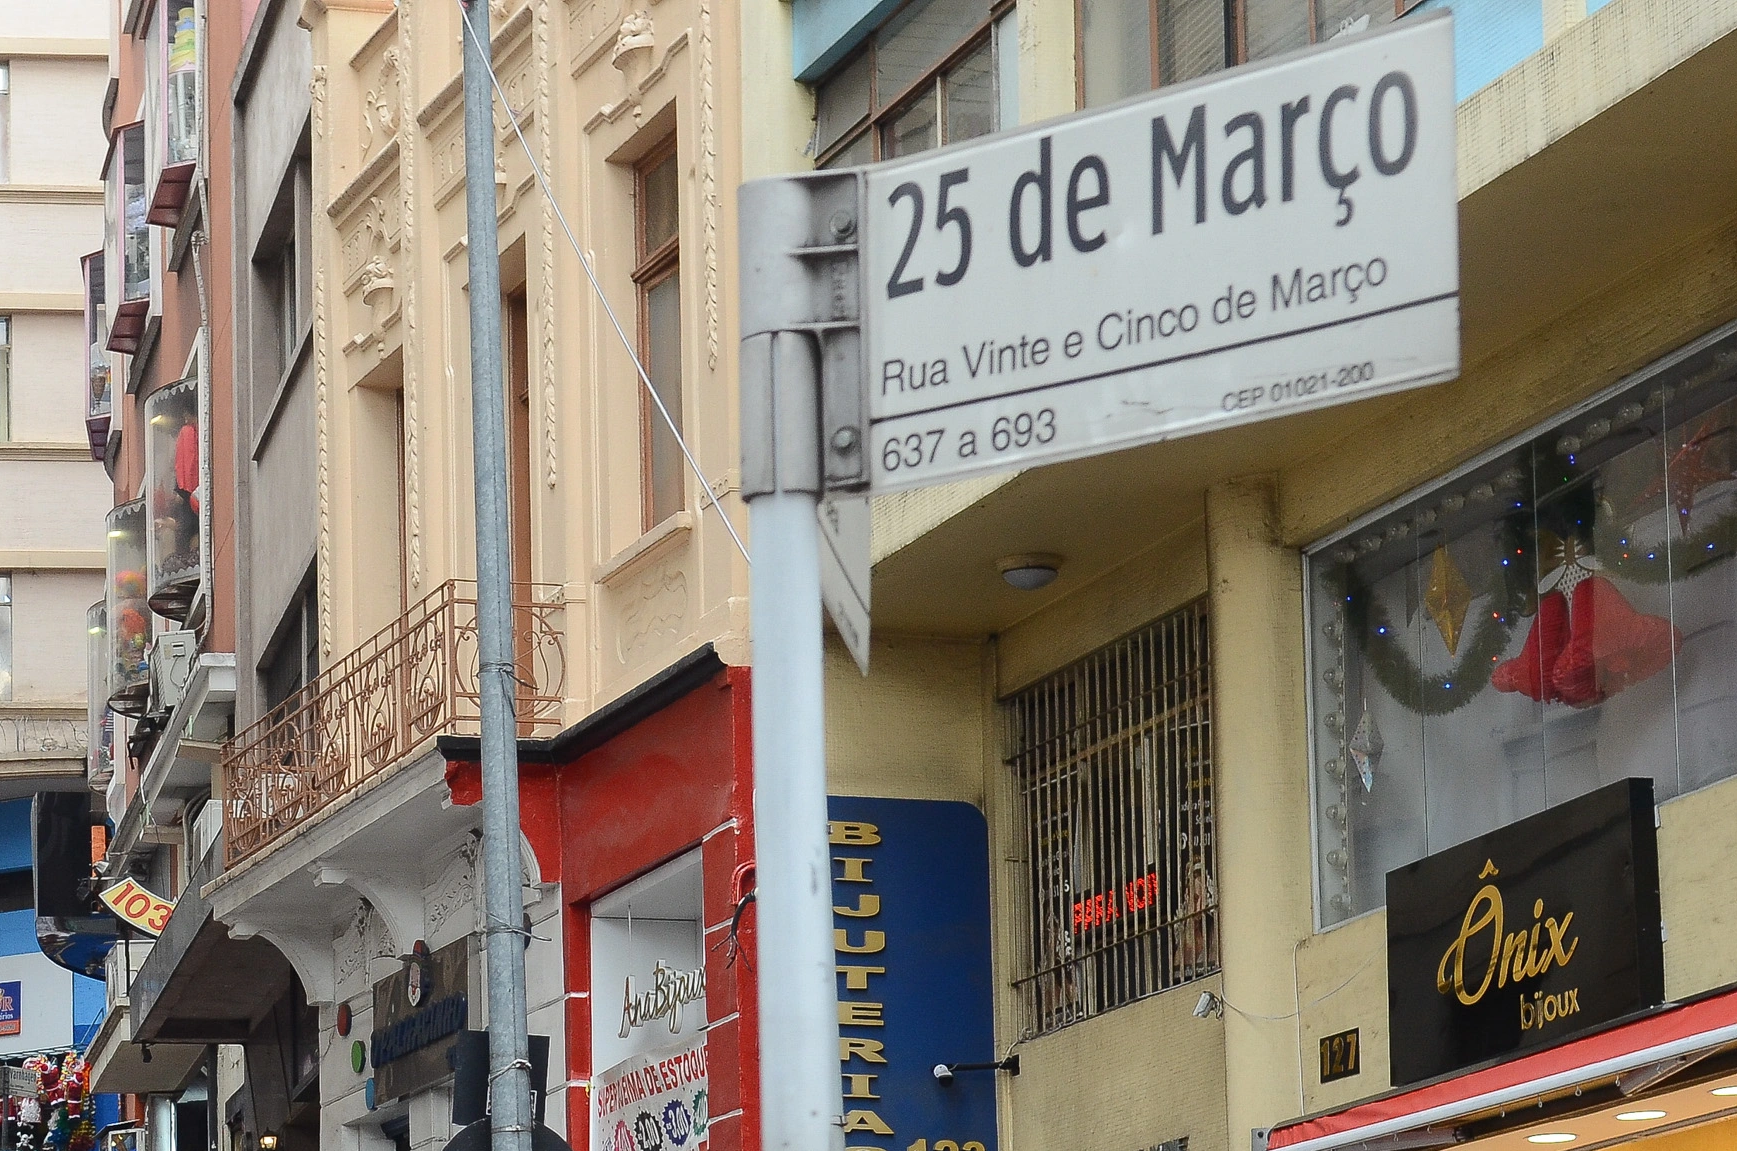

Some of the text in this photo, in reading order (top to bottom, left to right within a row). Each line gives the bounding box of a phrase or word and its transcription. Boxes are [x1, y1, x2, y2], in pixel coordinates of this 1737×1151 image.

[885, 70, 1419, 300] 25 de Março
[881, 253, 1388, 396] Rua Vinte e Cinco de Março
[1222, 361, 1375, 412] CEP 01021-200
[881, 409, 1056, 473] 637 a 693
[112, 882, 174, 932] 103
[1437, 858, 1579, 1006] Ônix
[1520, 987, 1581, 1030] bijoux
[1321, 1034, 1357, 1075] 127
[643, 1064, 663, 1097] DE
